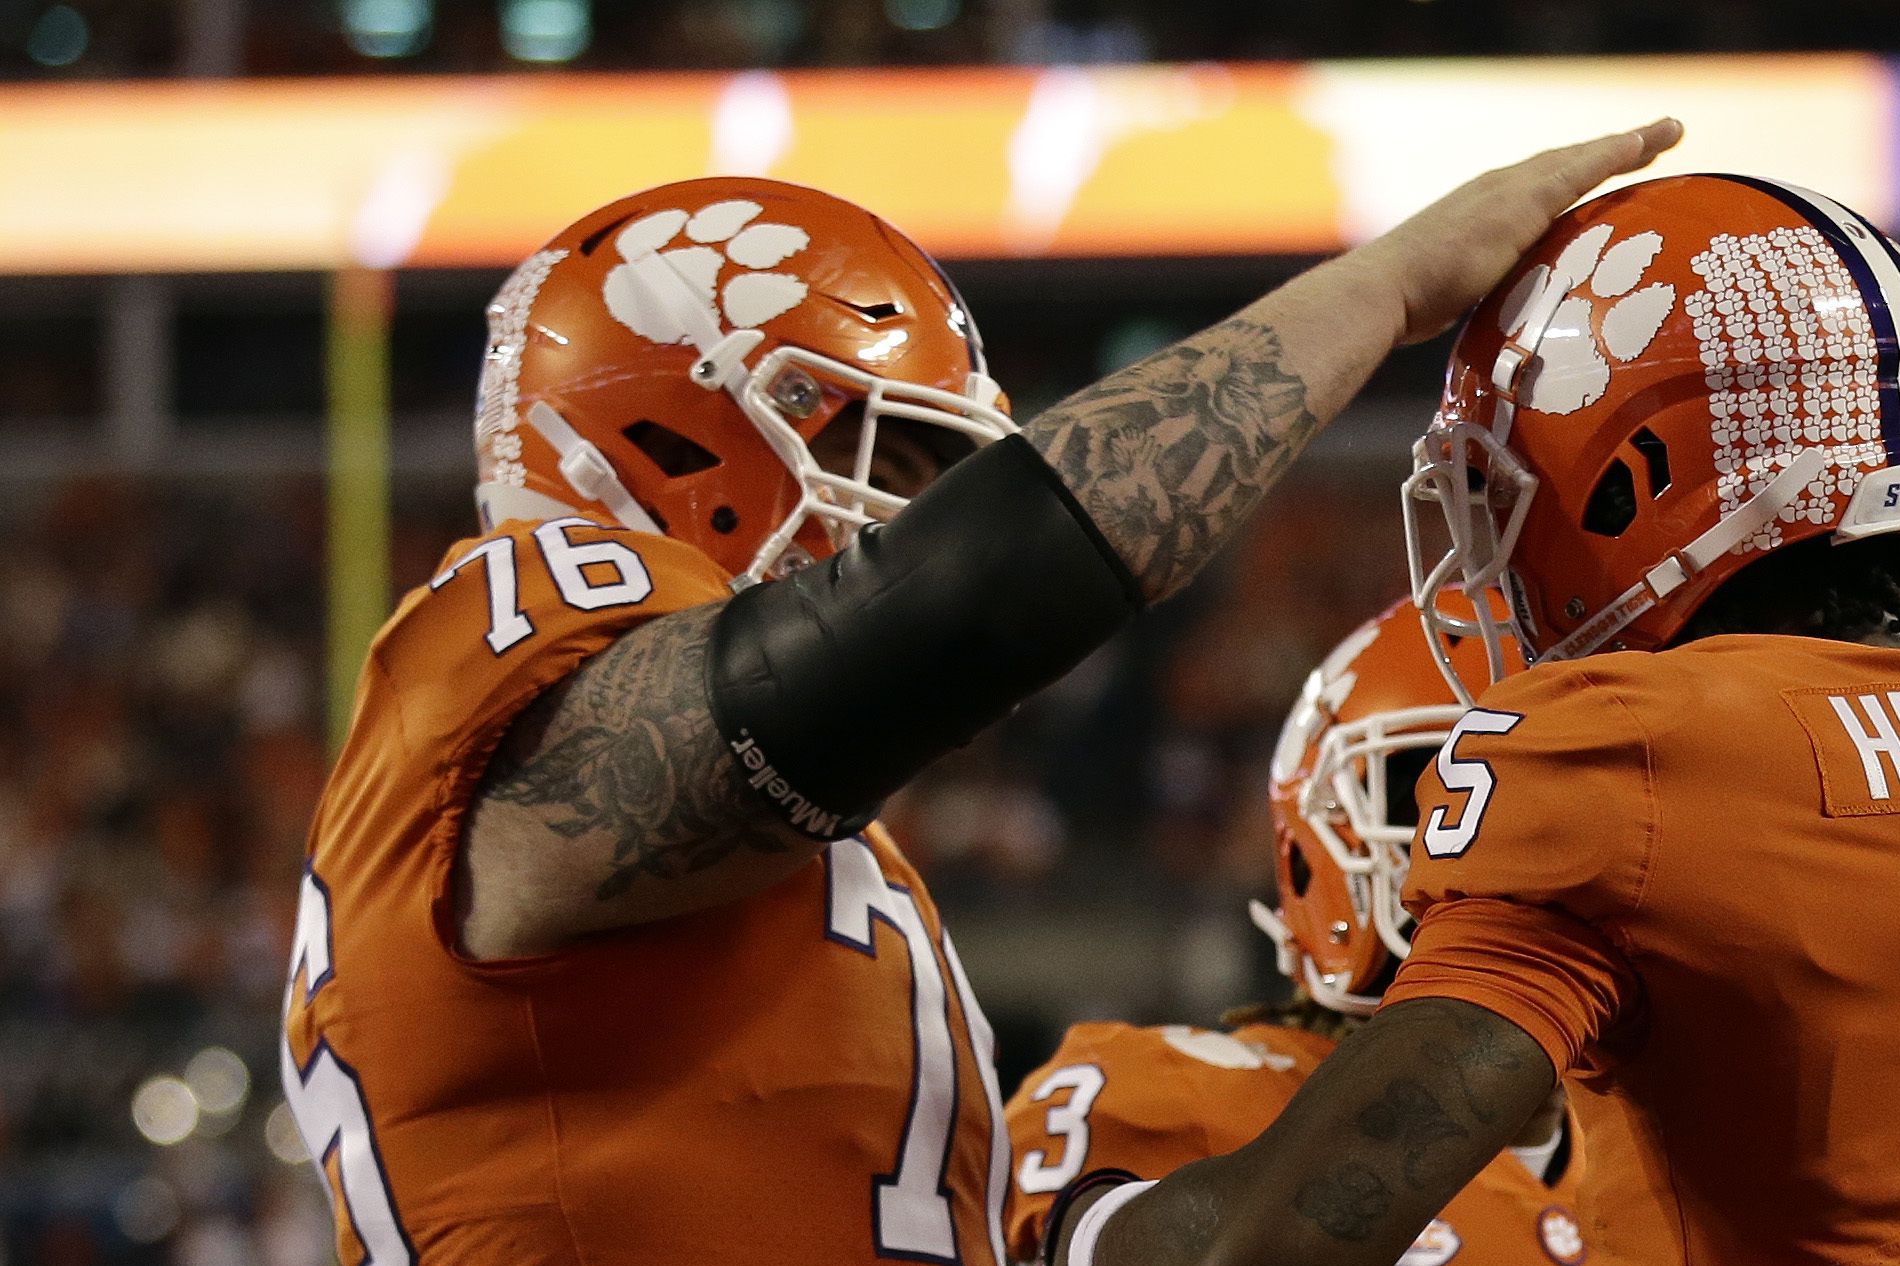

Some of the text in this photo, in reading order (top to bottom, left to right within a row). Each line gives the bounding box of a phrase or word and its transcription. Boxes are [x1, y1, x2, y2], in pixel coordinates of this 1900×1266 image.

[428, 516, 655, 657] 76
[1423, 707, 1527, 860] 5
[1018, 1064, 1107, 1194] 3
